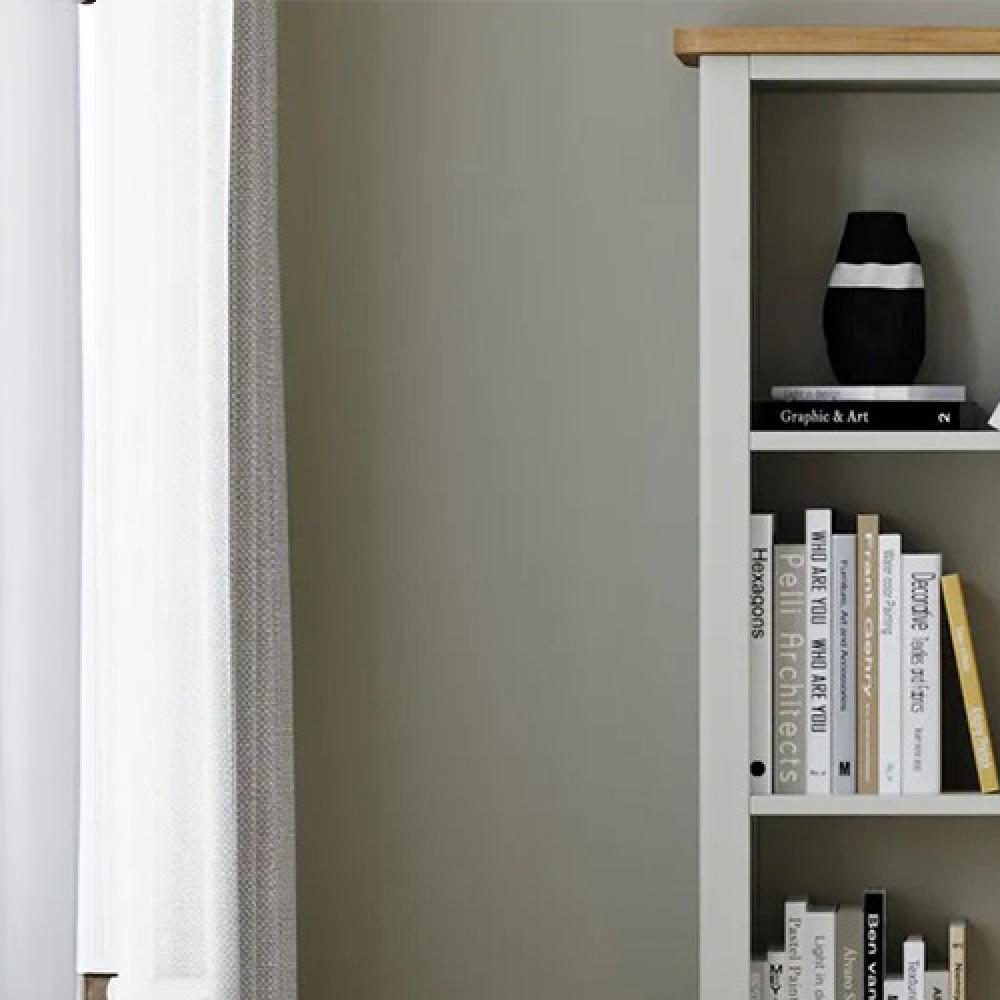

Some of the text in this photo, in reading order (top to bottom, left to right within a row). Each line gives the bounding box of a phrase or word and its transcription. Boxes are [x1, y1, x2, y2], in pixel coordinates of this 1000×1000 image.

[780, 409, 869, 427] Graphic & Art
[864, 532, 873, 608] Frank
[750, 548, 768, 639] Hexagons
[911, 572, 937, 630] Decorative
[810, 531, 826, 733] WHO ARE YOU WHO ARE YOU
[839, 610, 849, 626] Art
[839, 628, 849, 647] and
[779, 553, 804, 783] Pelli Architects
[862, 617, 874, 699] Gehry
[789, 917, 801, 960] Pastel
[813, 936, 826, 969] Light
[868, 913, 879, 955] Ben
[815, 974, 826, 985] in
[868, 961, 878, 1000] van
